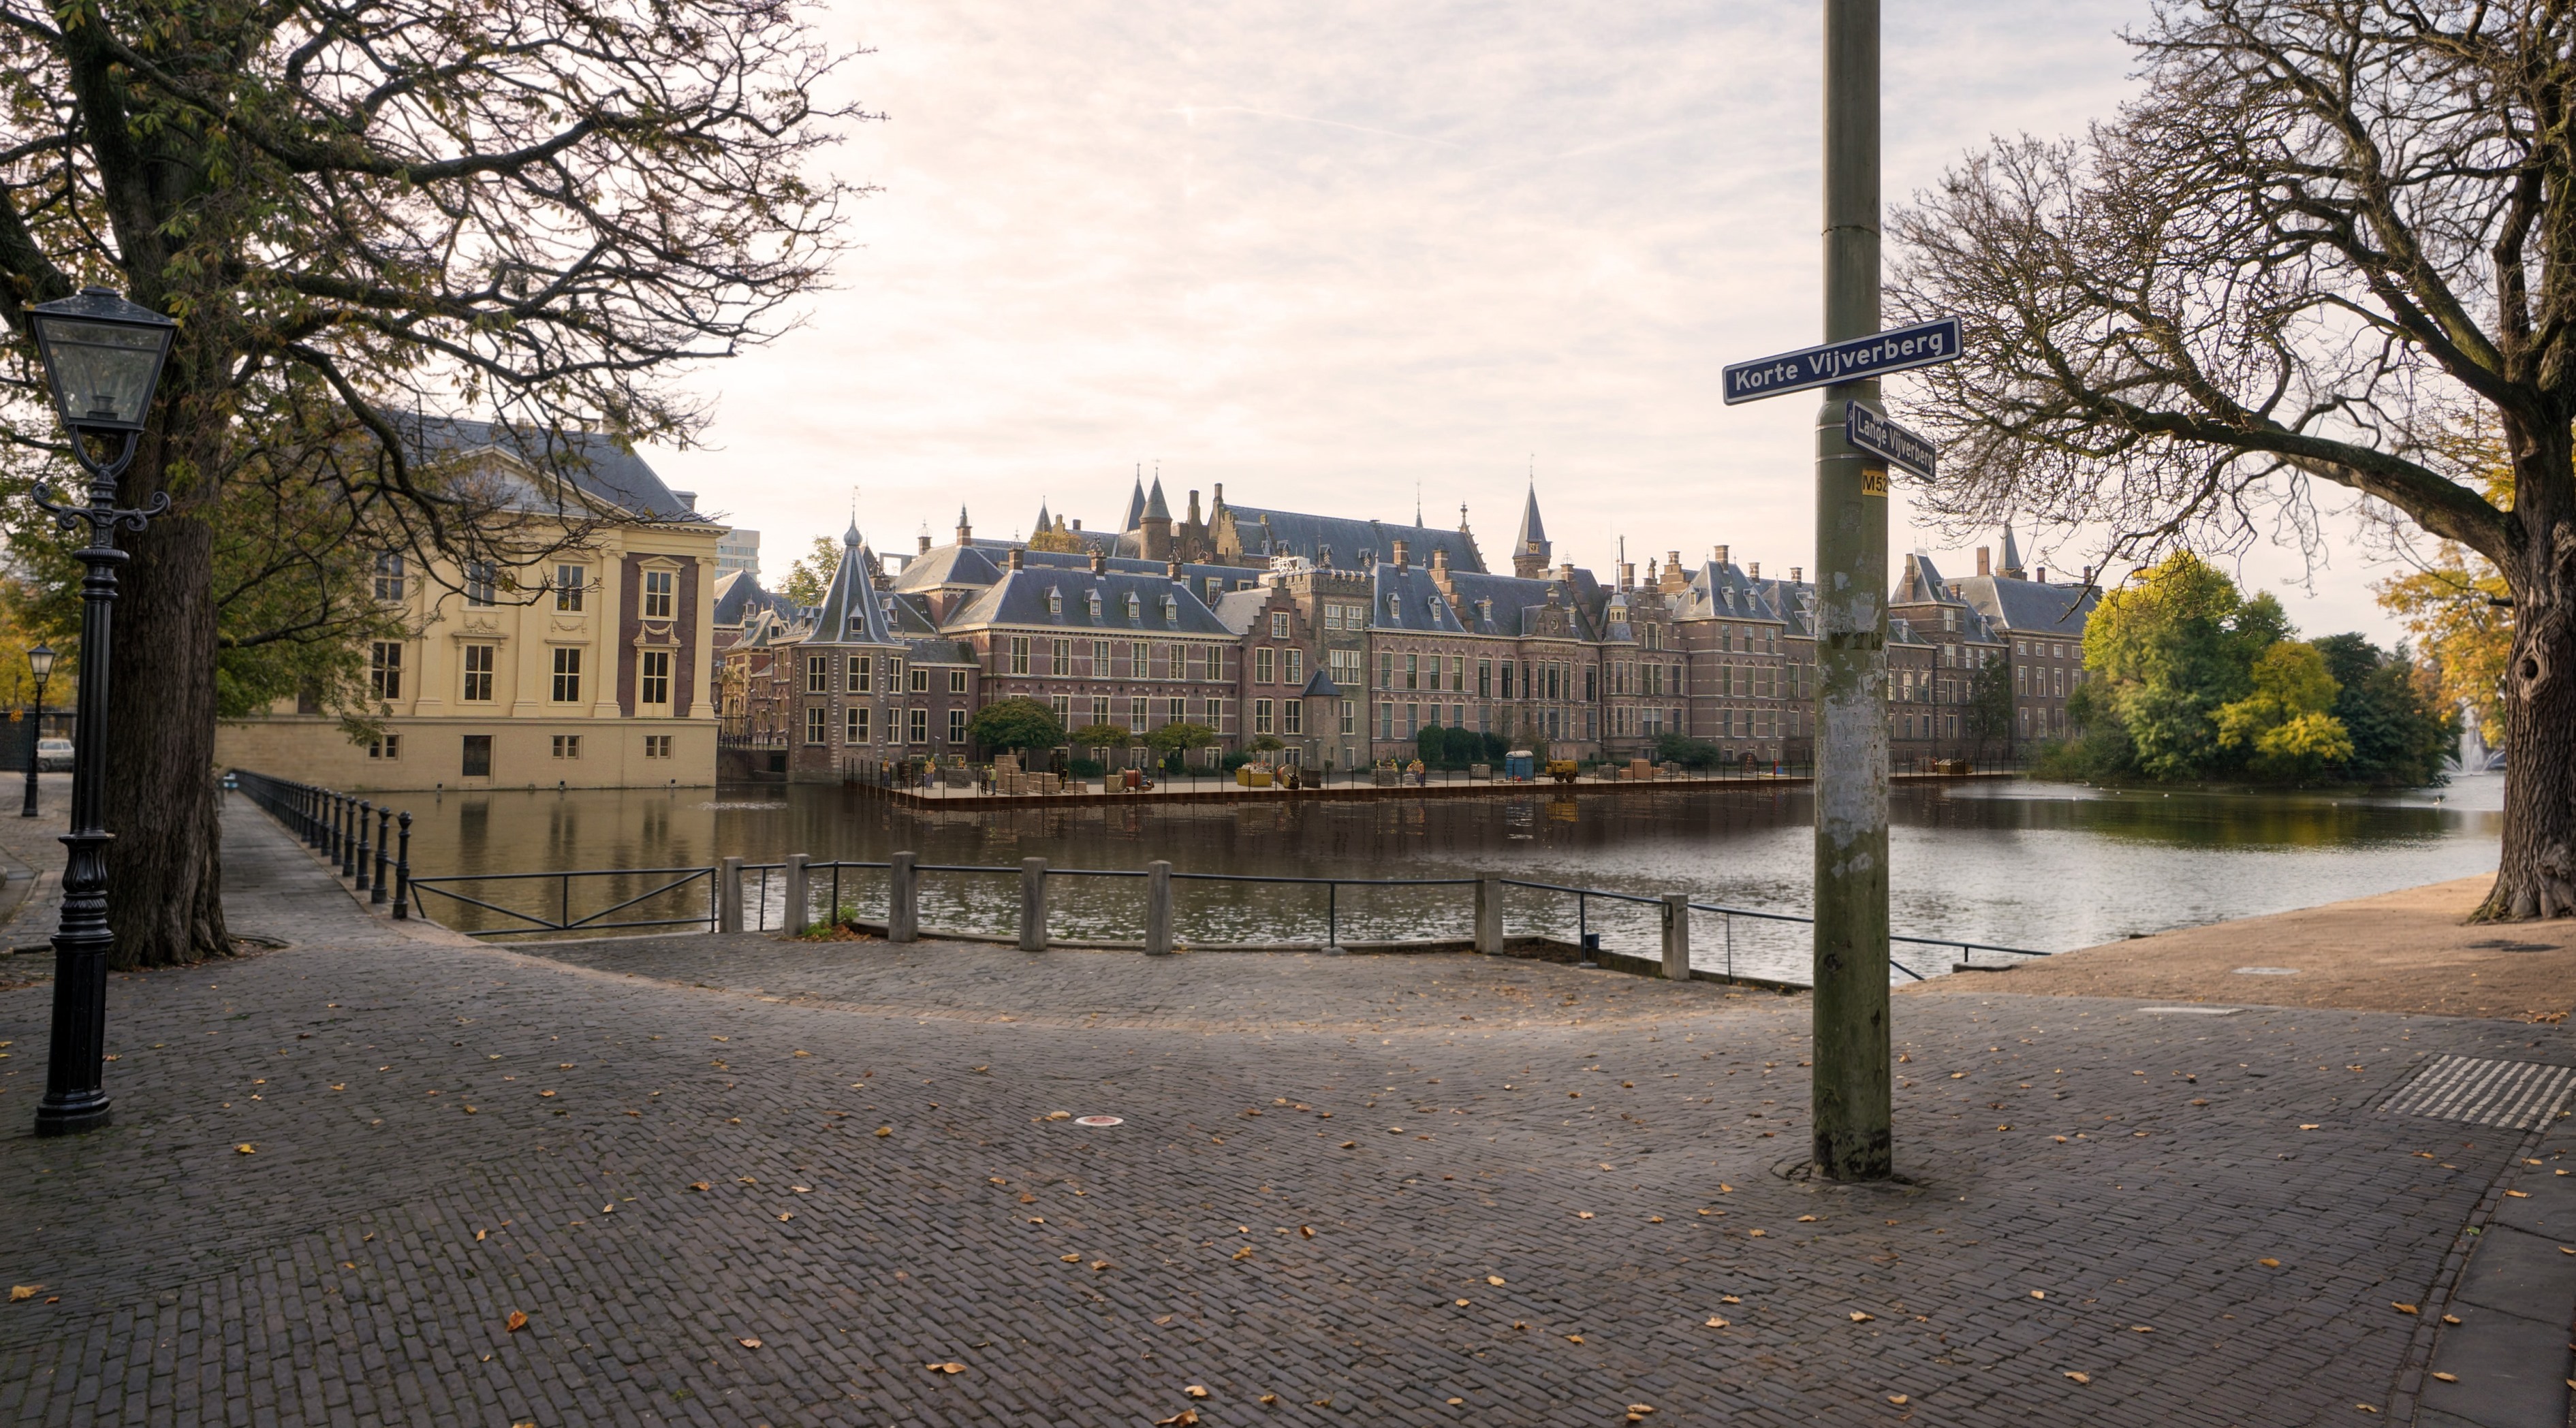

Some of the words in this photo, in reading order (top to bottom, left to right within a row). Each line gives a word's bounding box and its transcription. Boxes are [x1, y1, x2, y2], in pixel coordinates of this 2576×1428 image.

[1735, 364, 1798, 390] Korte
[1808, 332, 1943, 377] Vijverberg
[1857, 411, 1887, 448] Lange
[1889, 428, 1933, 475] Vijverberg
